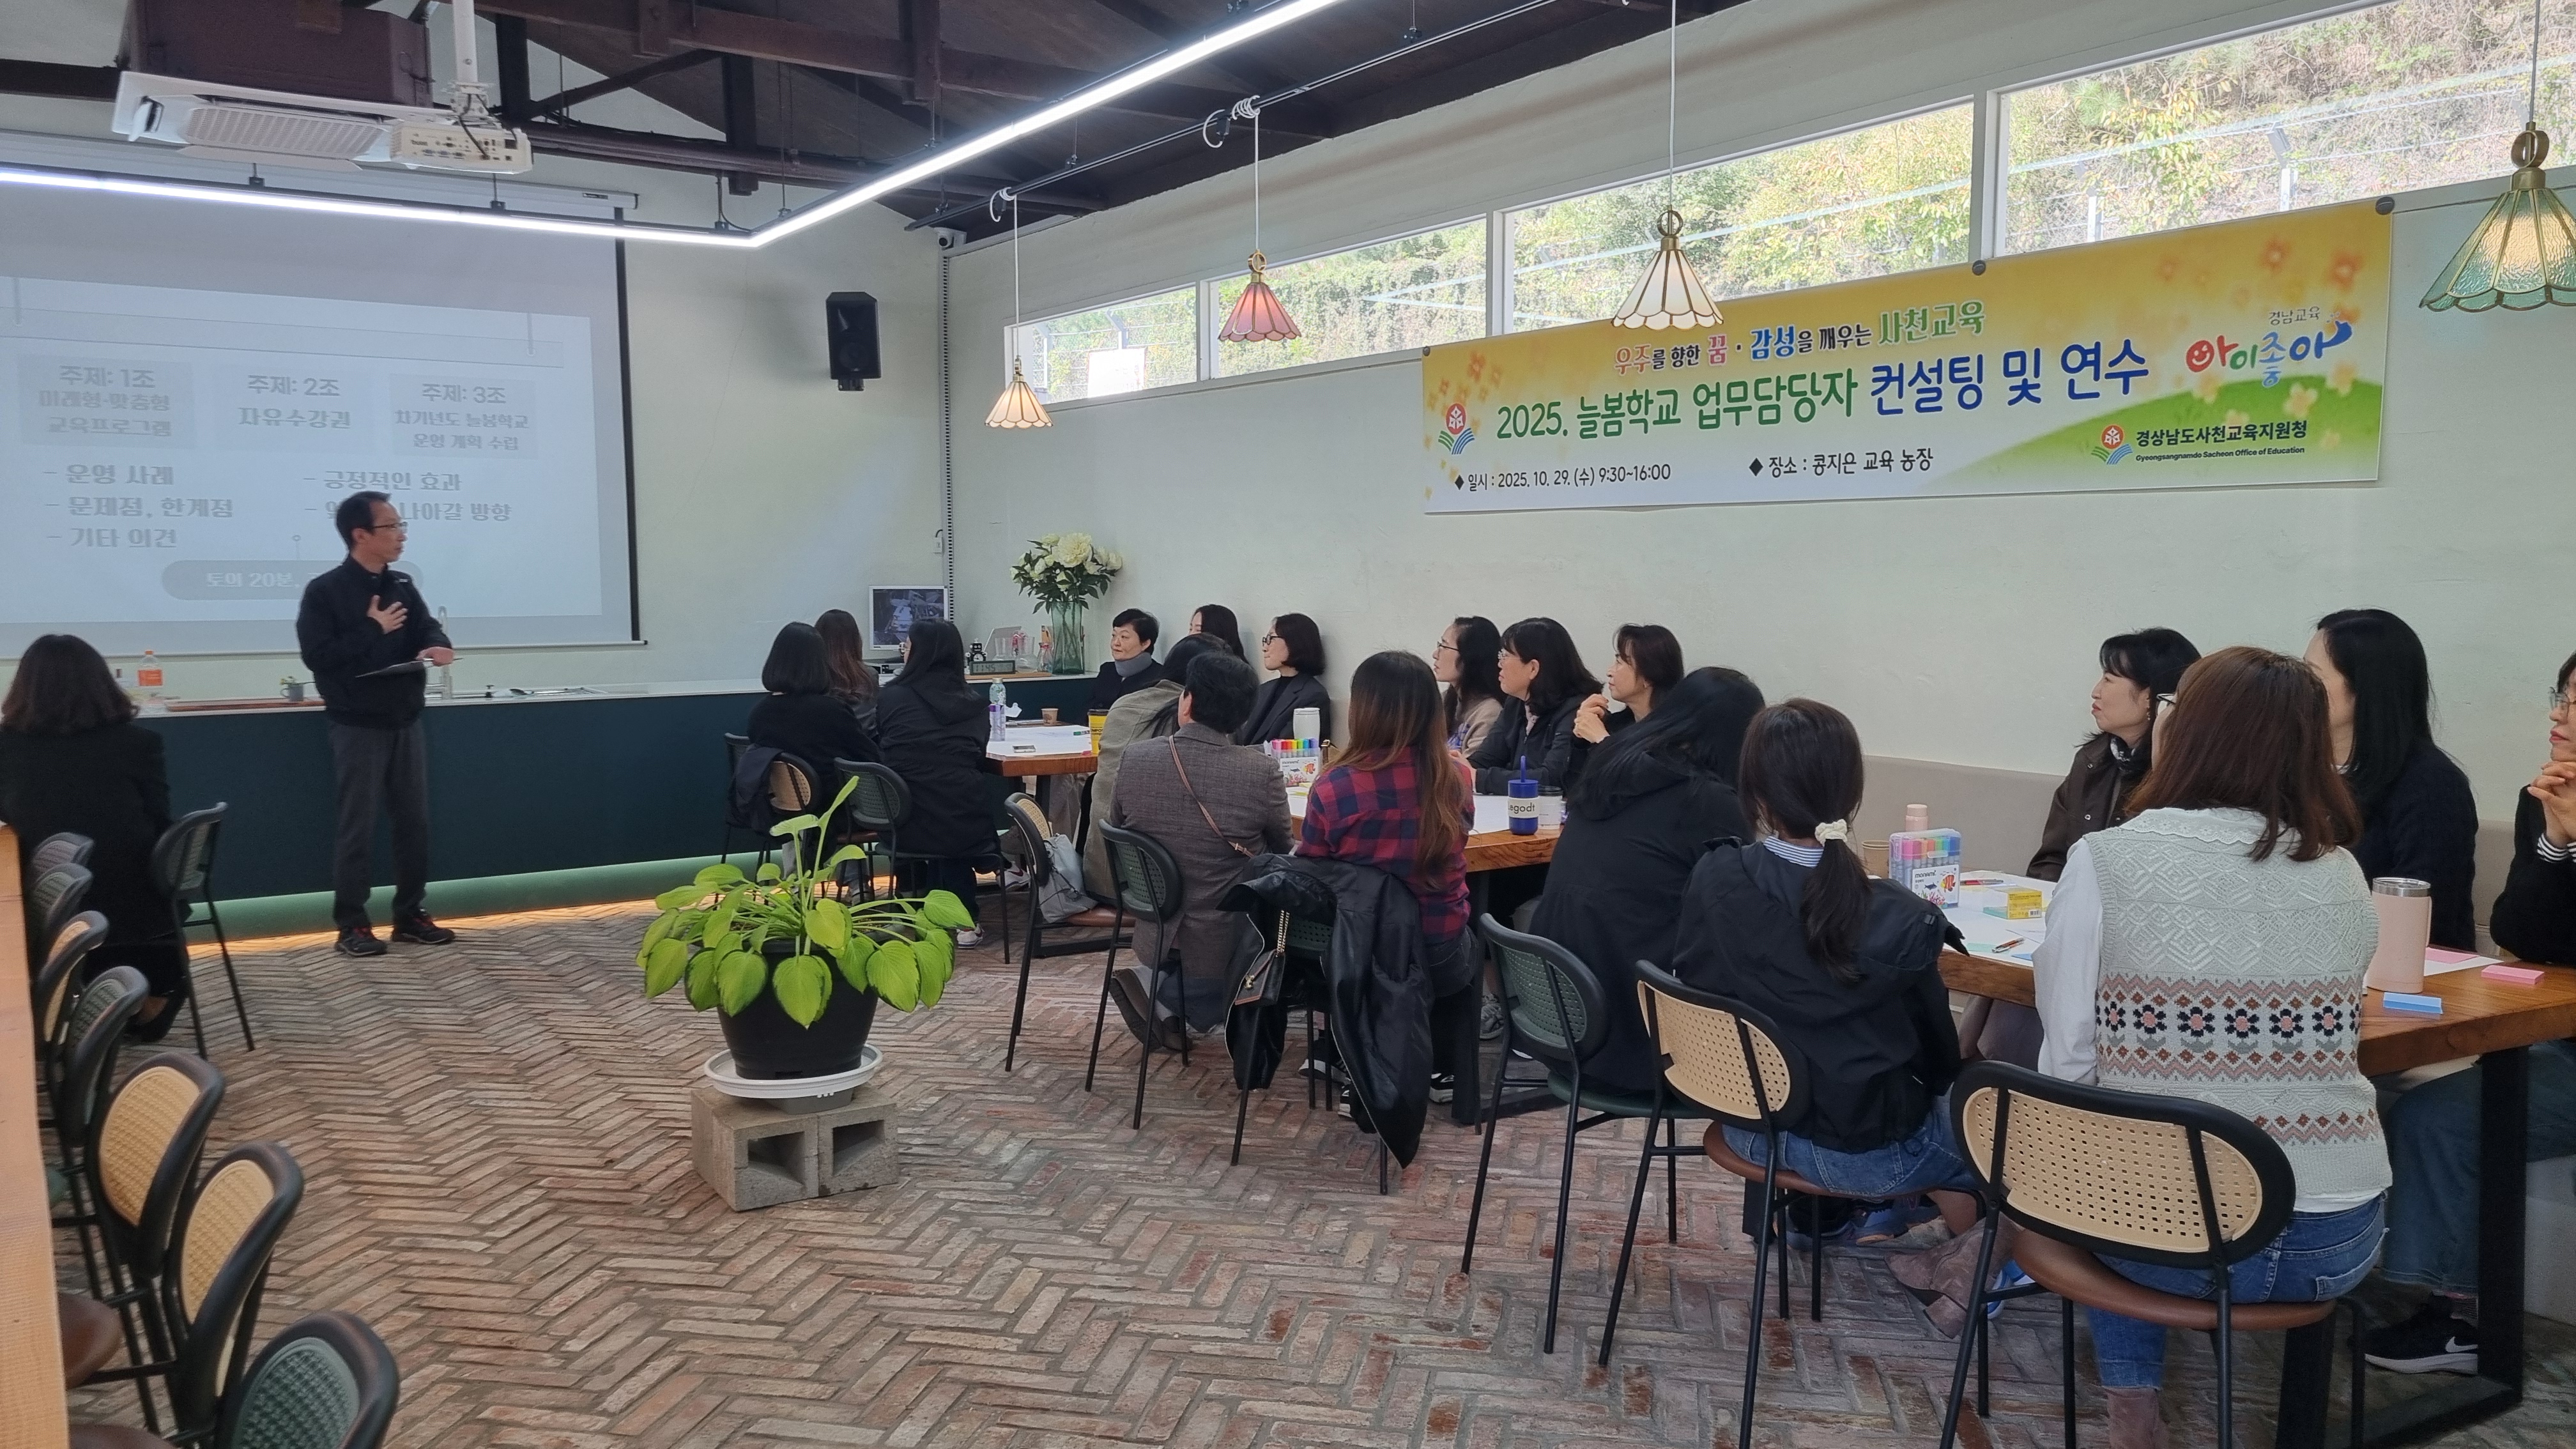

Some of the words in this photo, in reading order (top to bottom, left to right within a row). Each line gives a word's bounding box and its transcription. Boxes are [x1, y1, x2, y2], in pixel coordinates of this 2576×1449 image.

[2269, 306, 2320, 326] 경남교육
[1615, 345, 1666, 375] 우주를
[1671, 344, 1701, 369] 향한
[1708, 335, 1728, 365] 꿈
[1751, 325, 1814, 360] 감성을
[1819, 325, 1872, 351] 깨우는
[1879, 300, 1985, 346] 사천교육
[2186, 320, 2352, 388] 아이좋아
[59, 365, 114, 387] 주제:
[120, 369, 156, 389] 1조
[247, 374, 299, 396] 주제:
[303, 377, 341, 397] 2조
[422, 383, 468, 403] 주제:
[473, 385, 507, 404] 3조
[1496, 401, 1568, 440] 2025.
[1576, 388, 1682, 440] 늘봄학교
[1692, 367, 1859, 430] 업무담당자
[1870, 353, 1984, 417] 컨설팅
[2003, 347, 2043, 407] 및
[2060, 337, 2149, 400] 연수
[46, 416, 172, 437] 교육프로그램
[238, 407, 351, 429] 자유수강권
[2136, 420, 2308, 447] 경상남도사천교육지원청
[1769, 456, 1798, 479] 장소
[1812, 452, 1857, 477] 콩지은
[1862, 450, 1895, 473] 교육
[1899, 447, 1934, 472] 농장
[2135, 452, 2202, 462] Gyeongsangnamdo
[2203, 450, 2234, 459] Sacheon
[2235, 448, 2257, 457] Office
[2267, 447, 2305, 455] Education
[65, 464, 117, 485] 운영
[125, 464, 175, 486] 사례
[324, 470, 411, 491] 긍정적인
[420, 471, 463, 491] 효과
[1468, 473, 1488, 492] 일시
[1598, 463, 1671, 483] 9:30~16:00
[160, 497, 234, 519] 한계점
[470, 502, 512, 521] 방향
[70, 528, 121, 548] 기타
[127, 528, 178, 549] 의견
